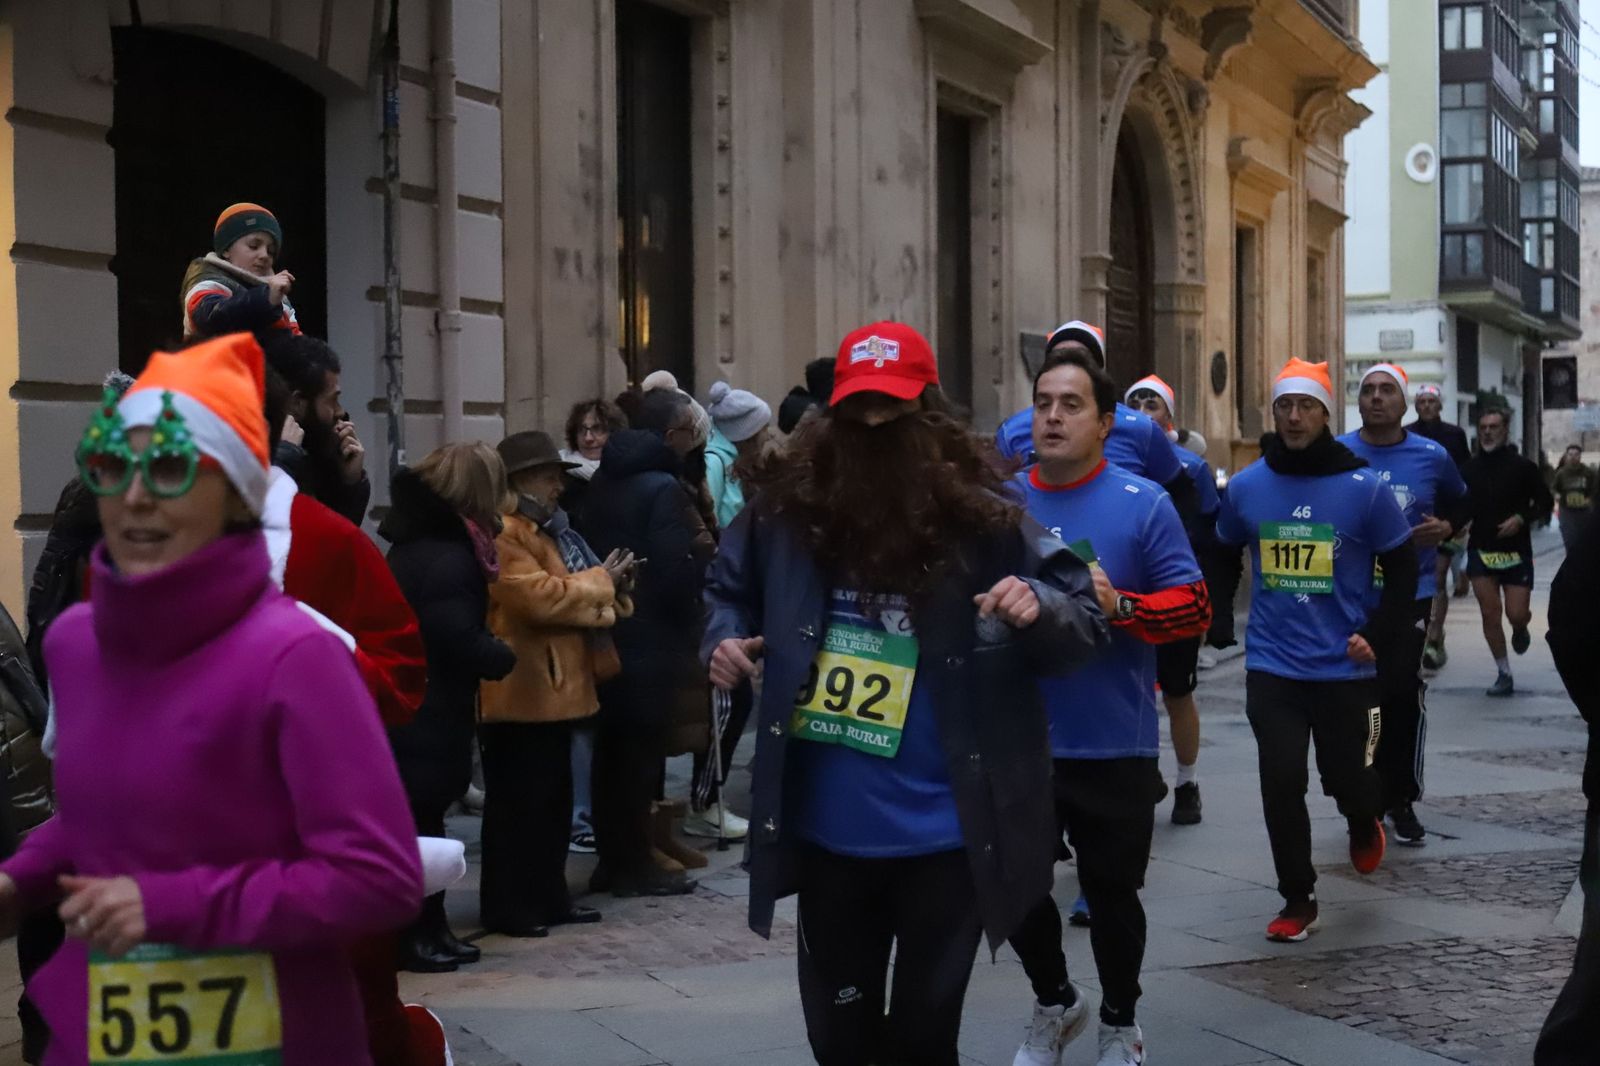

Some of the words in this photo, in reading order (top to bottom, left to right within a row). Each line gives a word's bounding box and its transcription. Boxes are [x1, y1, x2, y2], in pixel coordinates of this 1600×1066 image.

[1292, 506, 1311, 519] 46
[1270, 542, 1316, 571] 1117
[1300, 580, 1329, 589] RURAL
[825, 636, 848, 649] CAJA
[849, 639, 882, 655] RURAL
[810, 719, 843, 735] CAJA
[846, 725, 892, 748] RURAL
[101, 975, 247, 1057] 557
